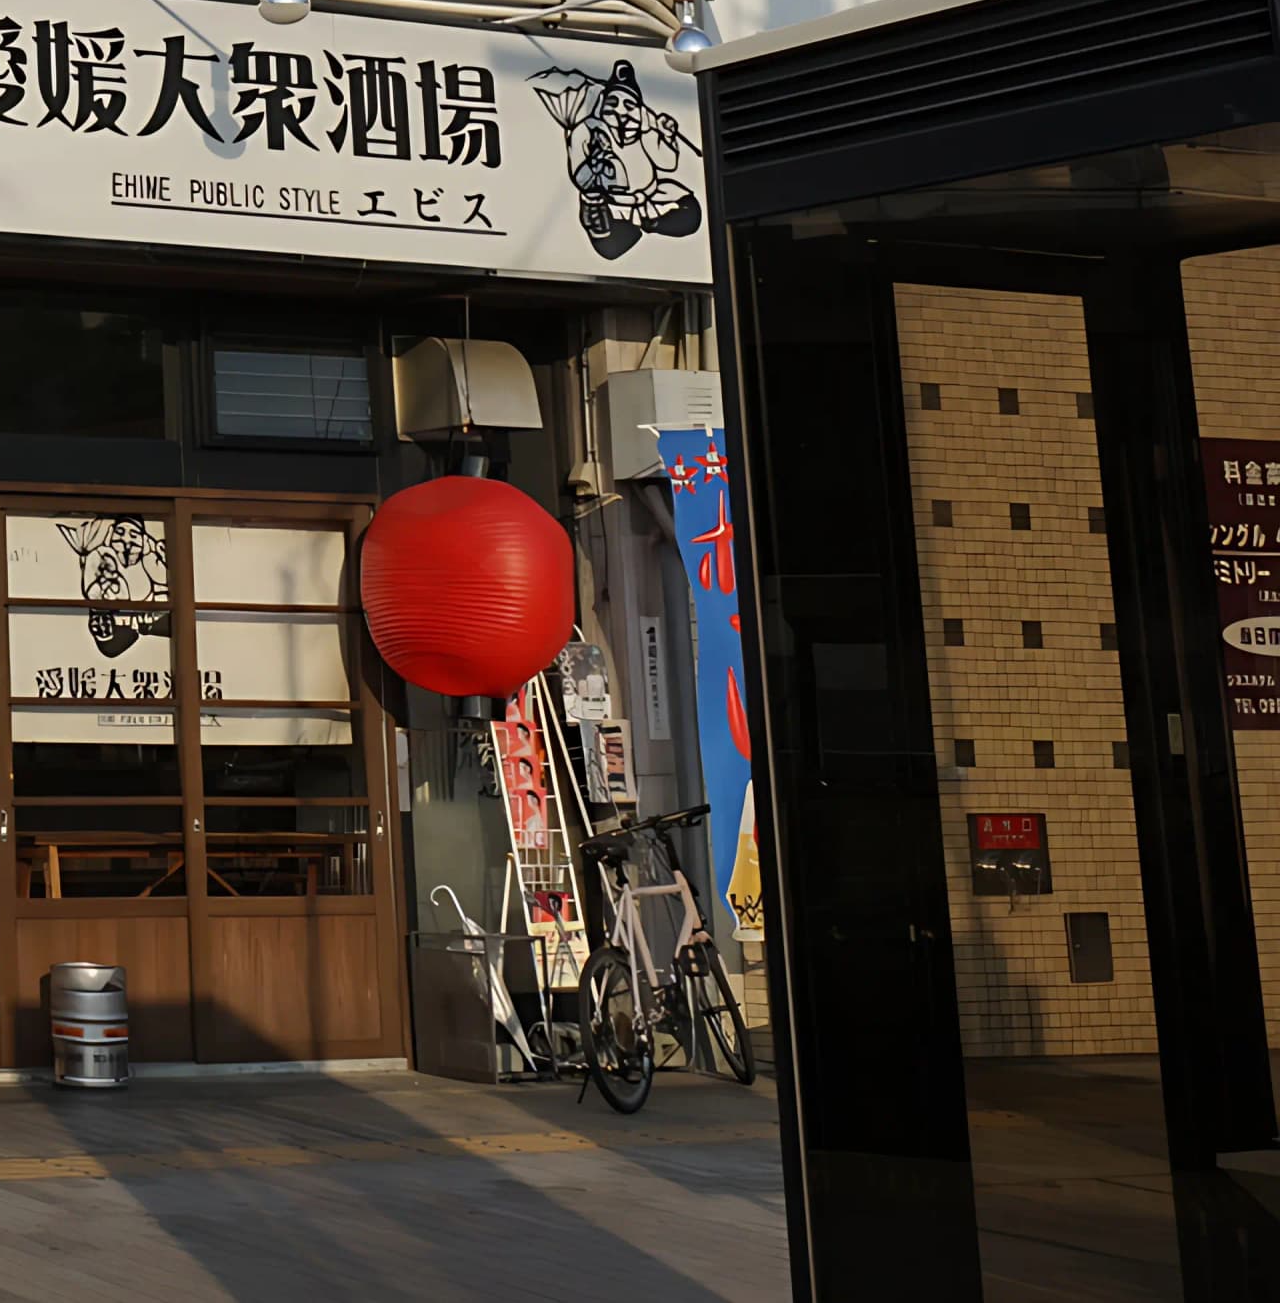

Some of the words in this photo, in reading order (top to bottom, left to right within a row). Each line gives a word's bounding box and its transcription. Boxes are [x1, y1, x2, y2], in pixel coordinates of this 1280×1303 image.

[190, 179, 265, 209] PUBLIC
[279, 186, 341, 215] STYLE
[356, 187, 493, 229] エビス
